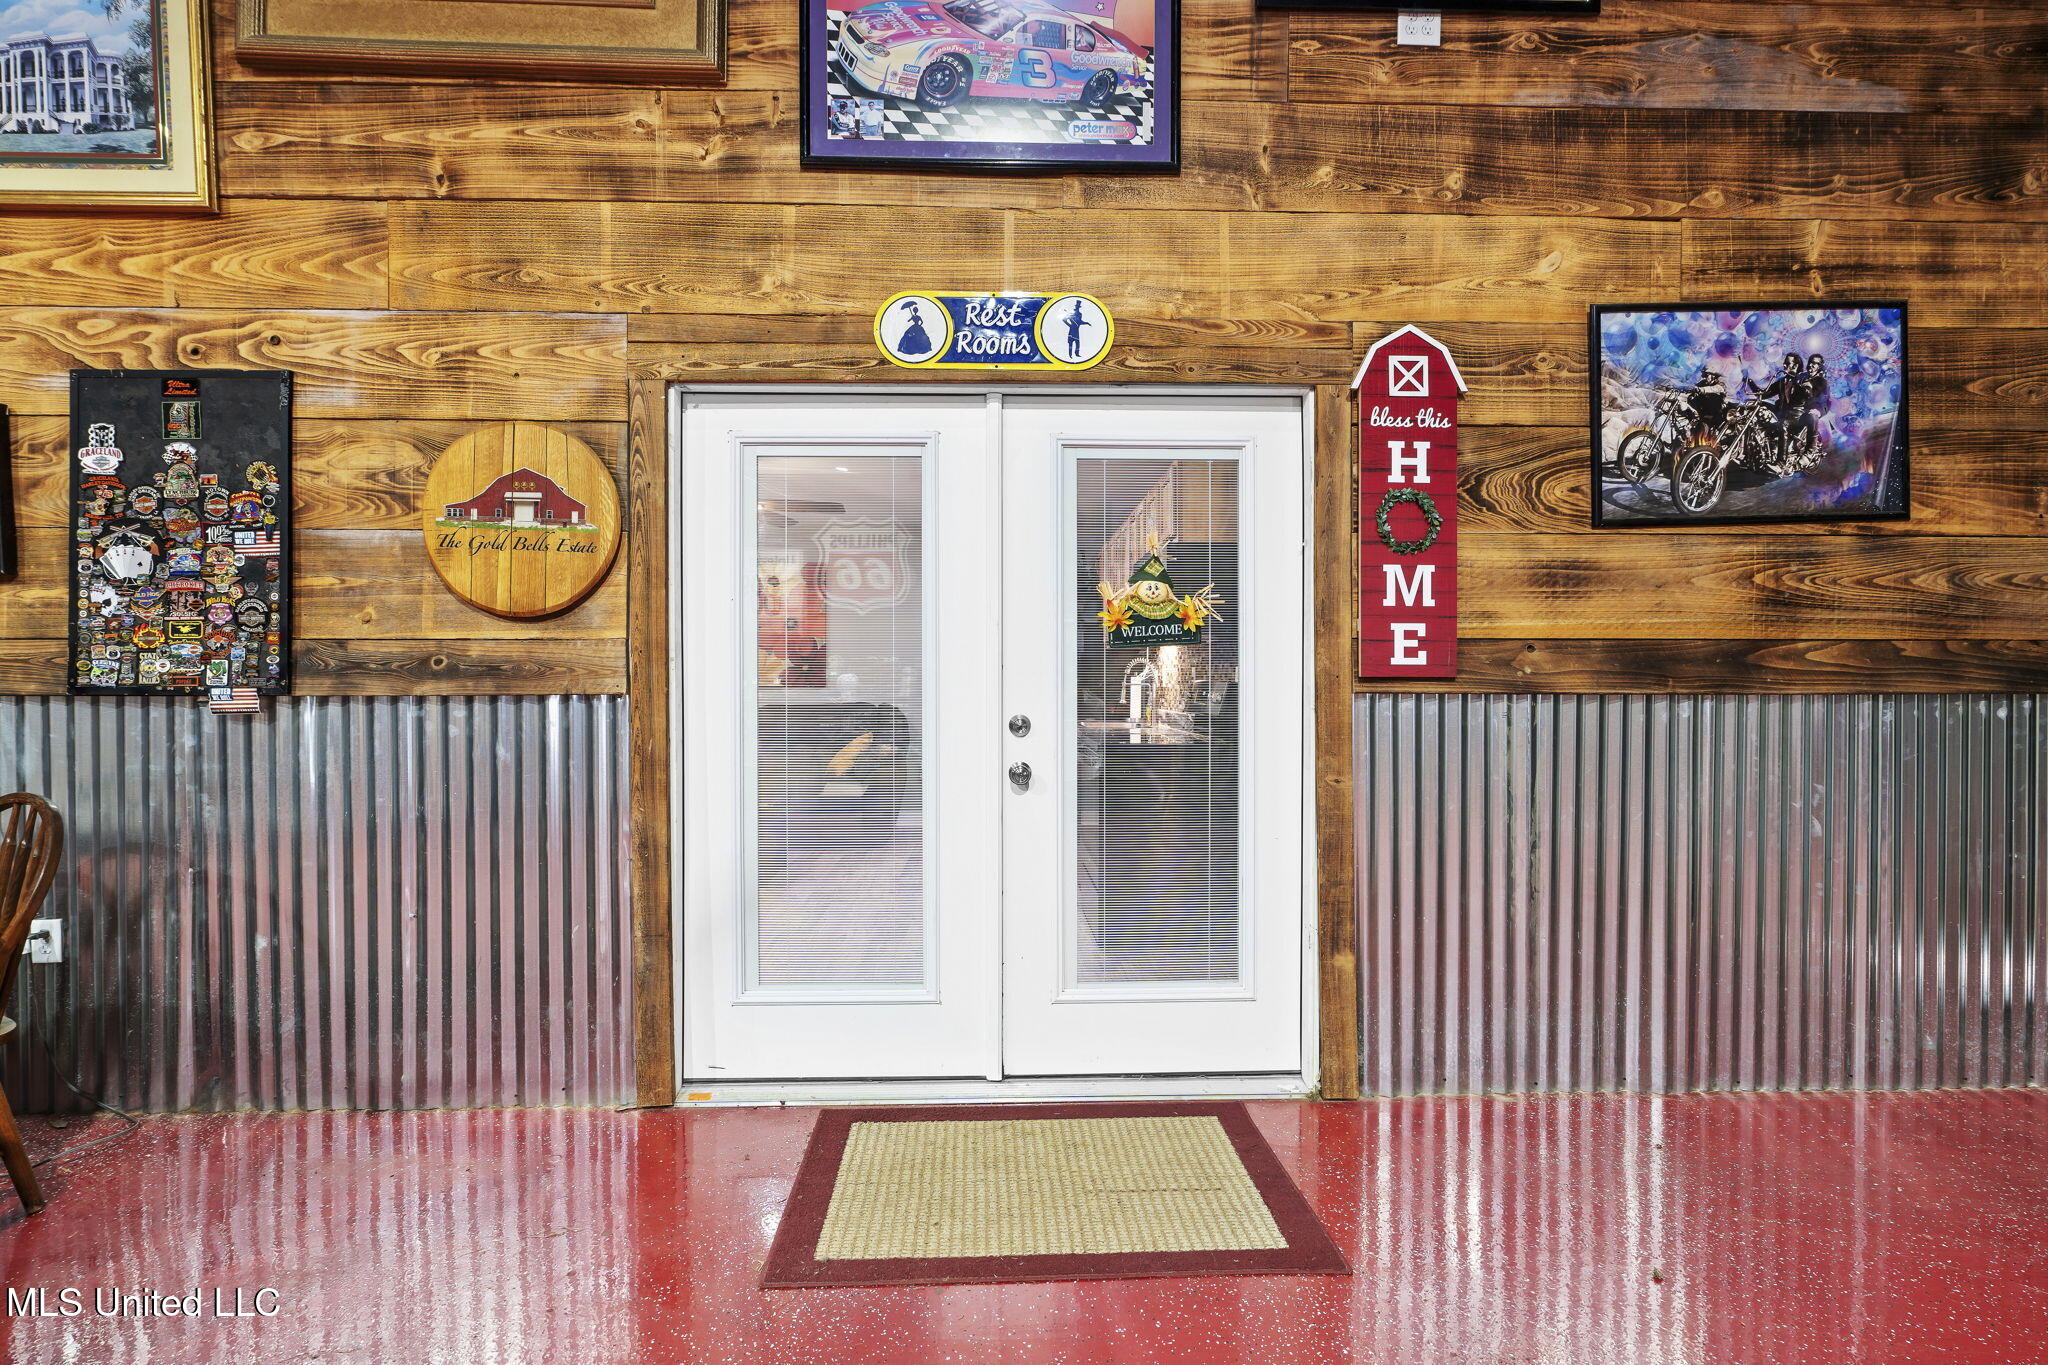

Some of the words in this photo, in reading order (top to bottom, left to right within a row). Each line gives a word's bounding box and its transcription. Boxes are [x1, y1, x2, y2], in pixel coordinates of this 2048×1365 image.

[1071, 51, 1134, 68] Goodwrench
[1018, 48, 1057, 89] 3
[1073, 122, 1104, 137] peter
[965, 302, 1022, 326] Rest
[957, 330, 1031, 355] Rooms
[163, 387, 197, 396] Limited
[1370, 406, 1413, 428] bless
[1417, 407, 1452, 428] this
[80, 447, 121, 459] GRACELAND
[234, 531, 255, 539] UNITED
[437, 526, 467, 549] The
[468, 529, 517, 556] Gold
[512, 531, 555, 552] Bells
[556, 538, 598, 554] Estate
[1121, 623, 1183, 638] WELCOME
